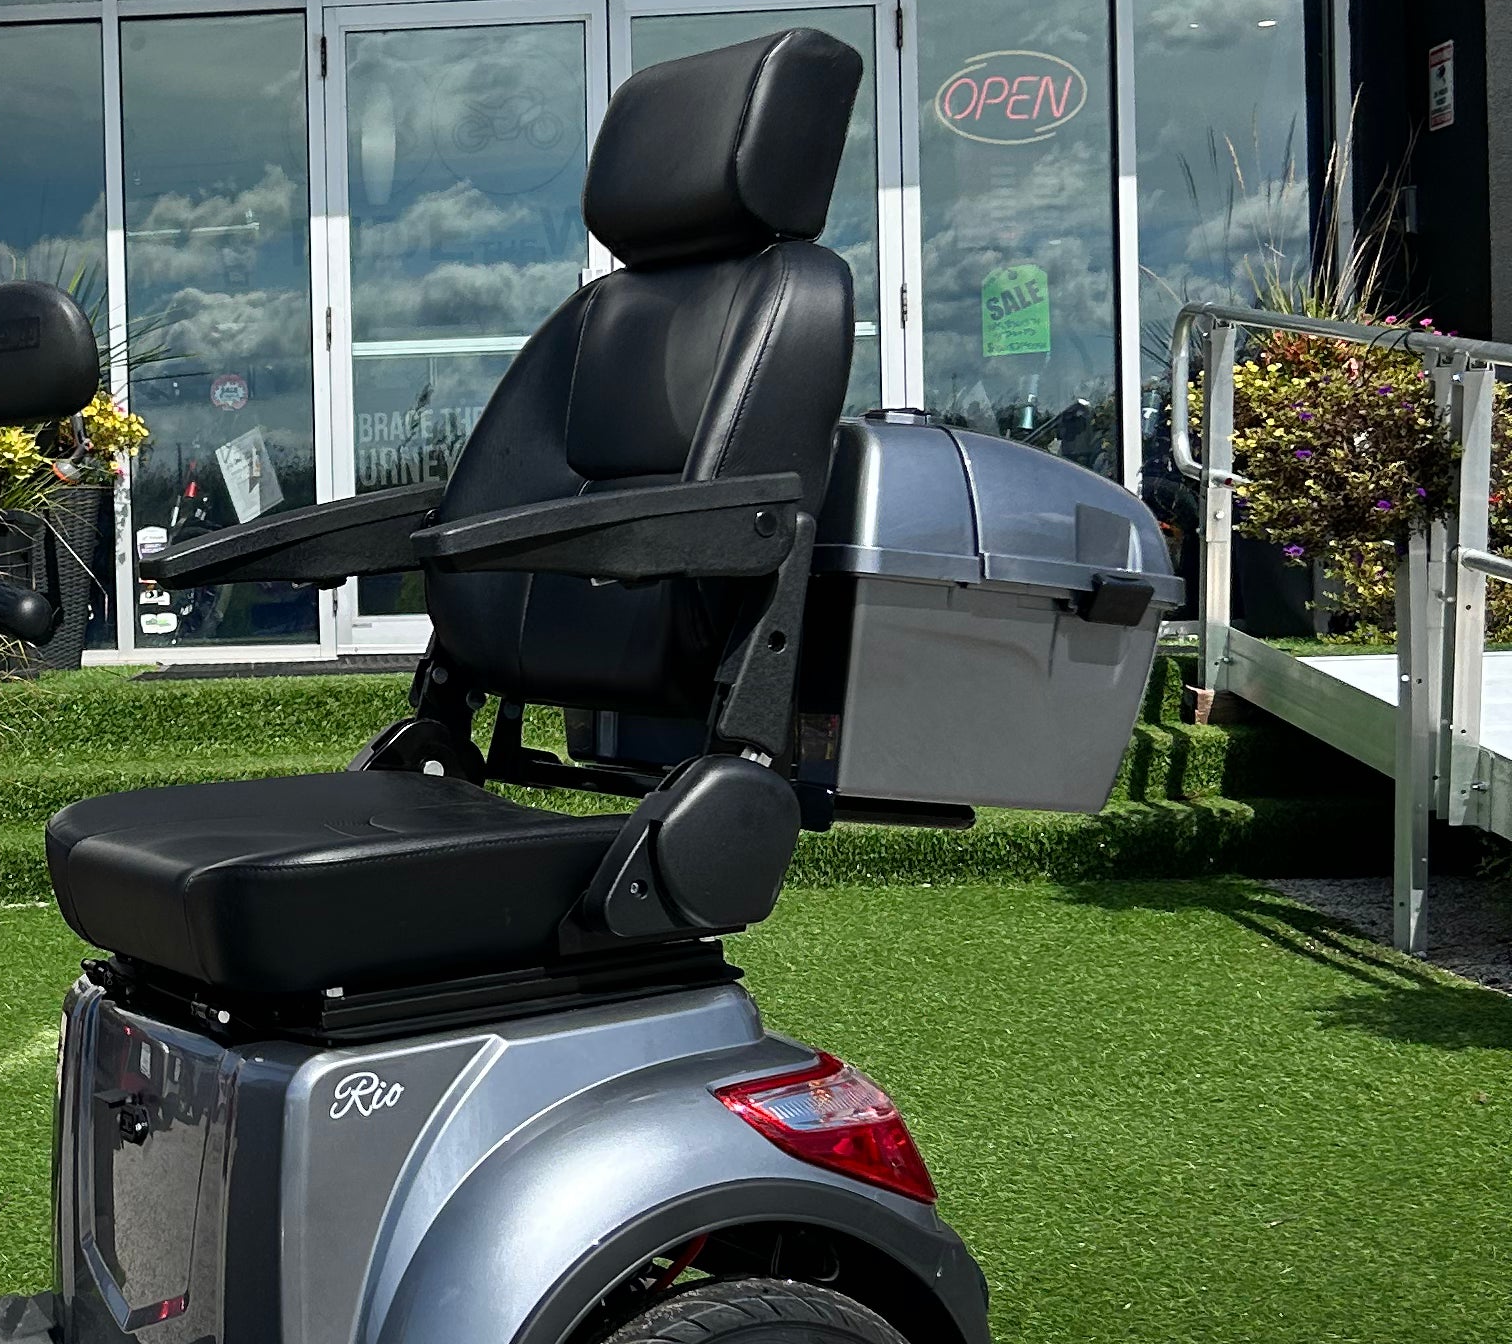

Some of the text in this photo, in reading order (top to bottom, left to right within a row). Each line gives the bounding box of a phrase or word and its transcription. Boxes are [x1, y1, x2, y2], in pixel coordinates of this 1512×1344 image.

[943, 75, 1073, 121] OPEN
[985, 278, 1045, 321] SALE
[358, 408, 434, 444] BRACE
[329, 1070, 405, 1120] Rio
